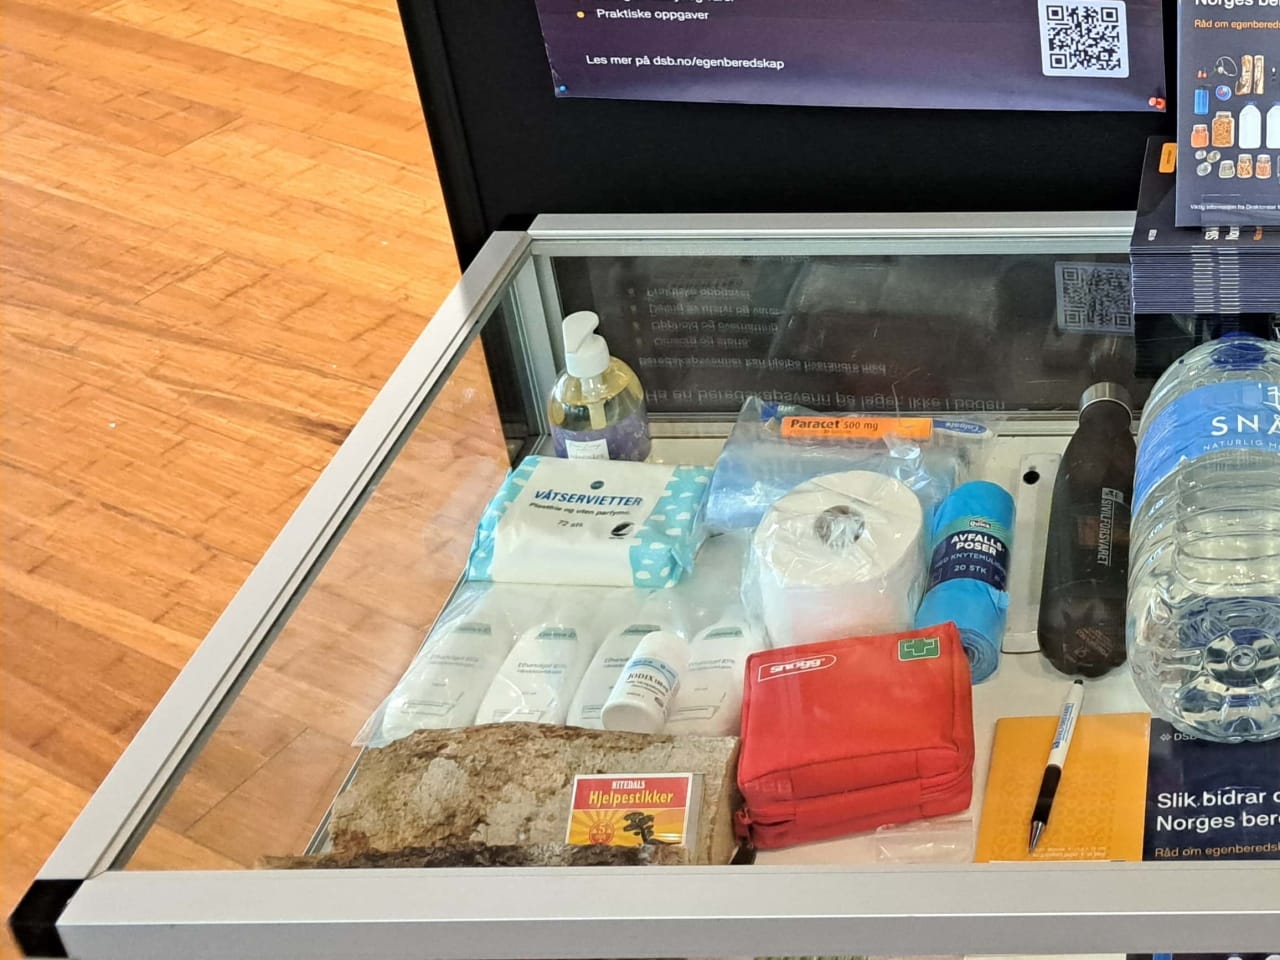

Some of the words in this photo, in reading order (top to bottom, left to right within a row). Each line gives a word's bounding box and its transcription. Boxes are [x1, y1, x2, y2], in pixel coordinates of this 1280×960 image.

[597, 9, 651, 20] Praktiske
[654, 10, 709, 23] oppgaver
[1195, 19, 1212, 28] Råd
[586, 55, 608, 66] Les
[611, 56, 632, 66] mer
[635, 55, 651, 69] på
[653, 55, 785, 71] dsb.no/egenberedskap
[790, 418, 841, 429] Paracet
[843, 421, 861, 429] 500
[863, 422, 879, 431] mg
[1203, 439, 1263, 452] NATURLIG
[534, 489, 644, 506] VÅTSERVIETTER
[956, 542, 997, 556] POSER
[954, 564, 966, 572] 20
[969, 565, 987, 574] STK
[588, 790, 674, 808] Hjelpestikker
[1157, 793, 1196, 808] Slik
[1203, 789, 1266, 806] bidrar
[1157, 813, 1235, 833] Norges
[1155, 847, 1179, 857] Råd
[1182, 847, 1202, 856] om
